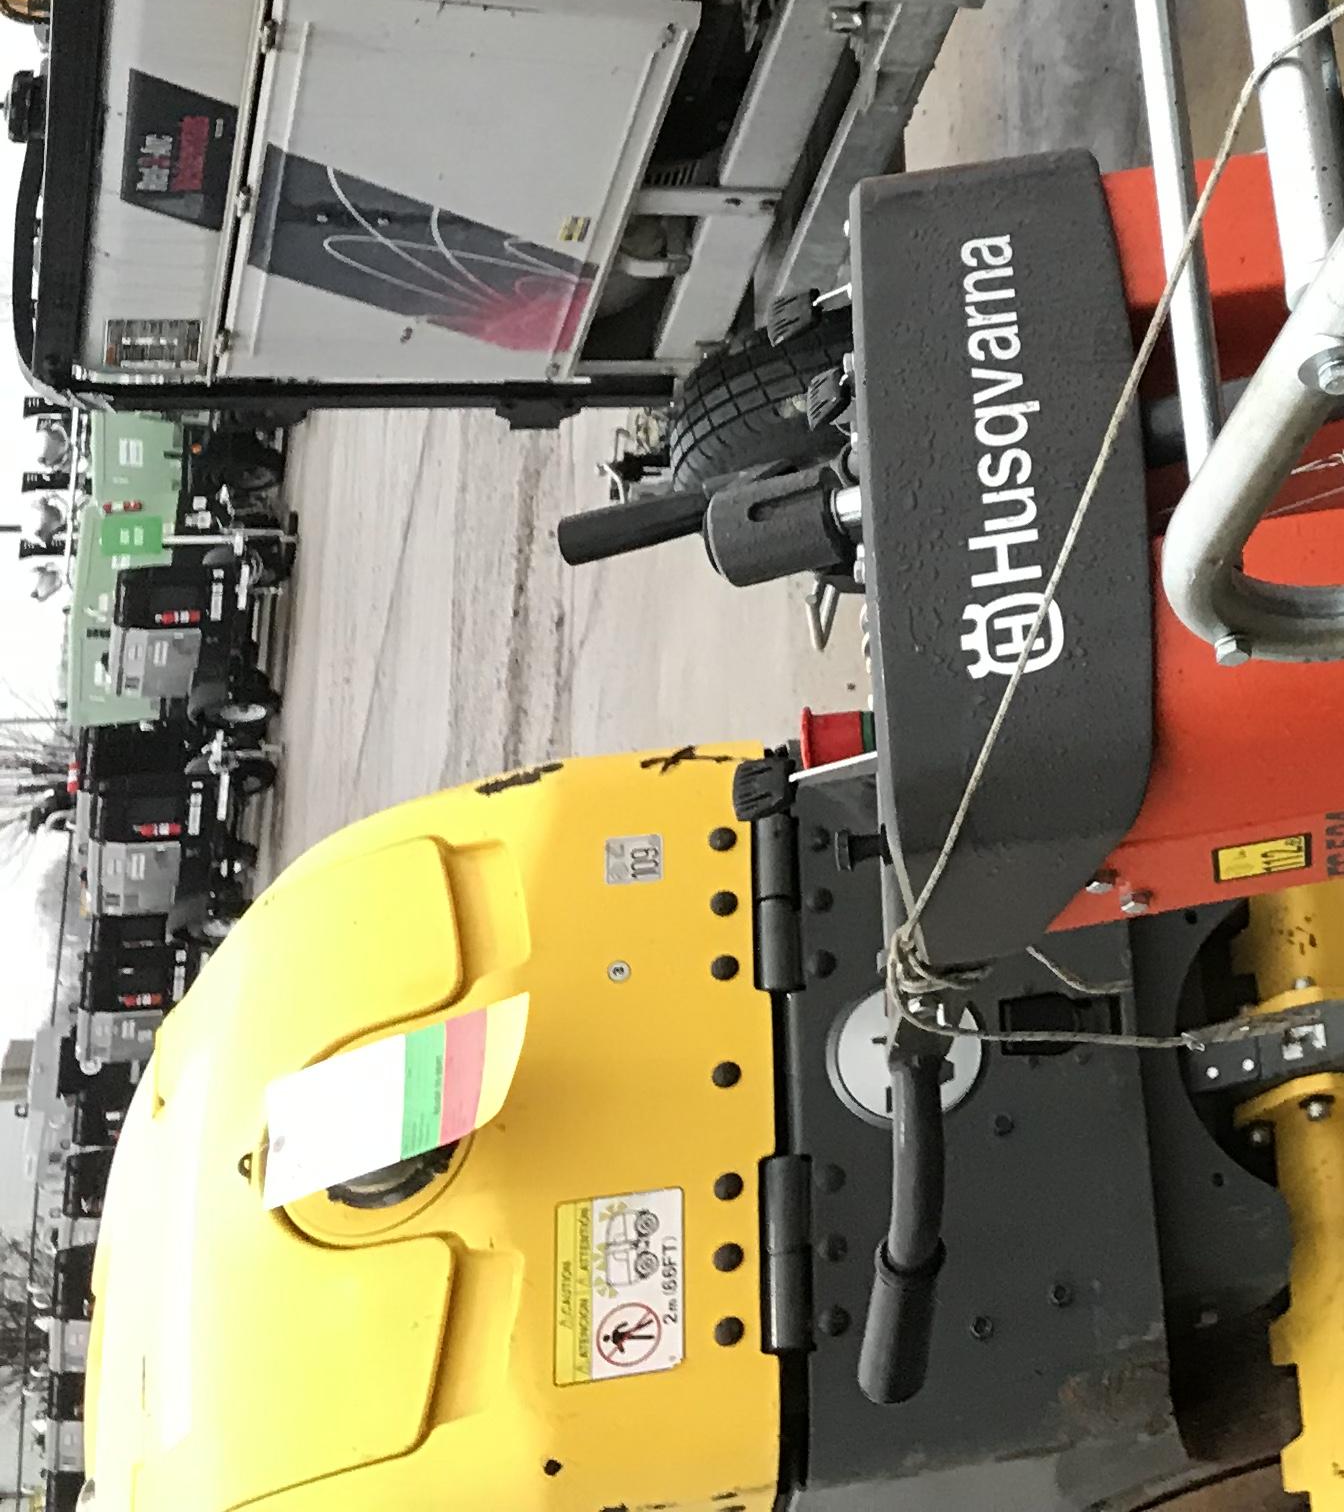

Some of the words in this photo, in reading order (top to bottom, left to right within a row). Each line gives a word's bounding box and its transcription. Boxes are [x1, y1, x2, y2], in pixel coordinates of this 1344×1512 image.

[960, 234, 1042, 588] Husqvarna
[630, 847, 659, 879] 109
[1261, 845, 1303, 872] 112
[560, 1260, 572, 1316] CAUTION
